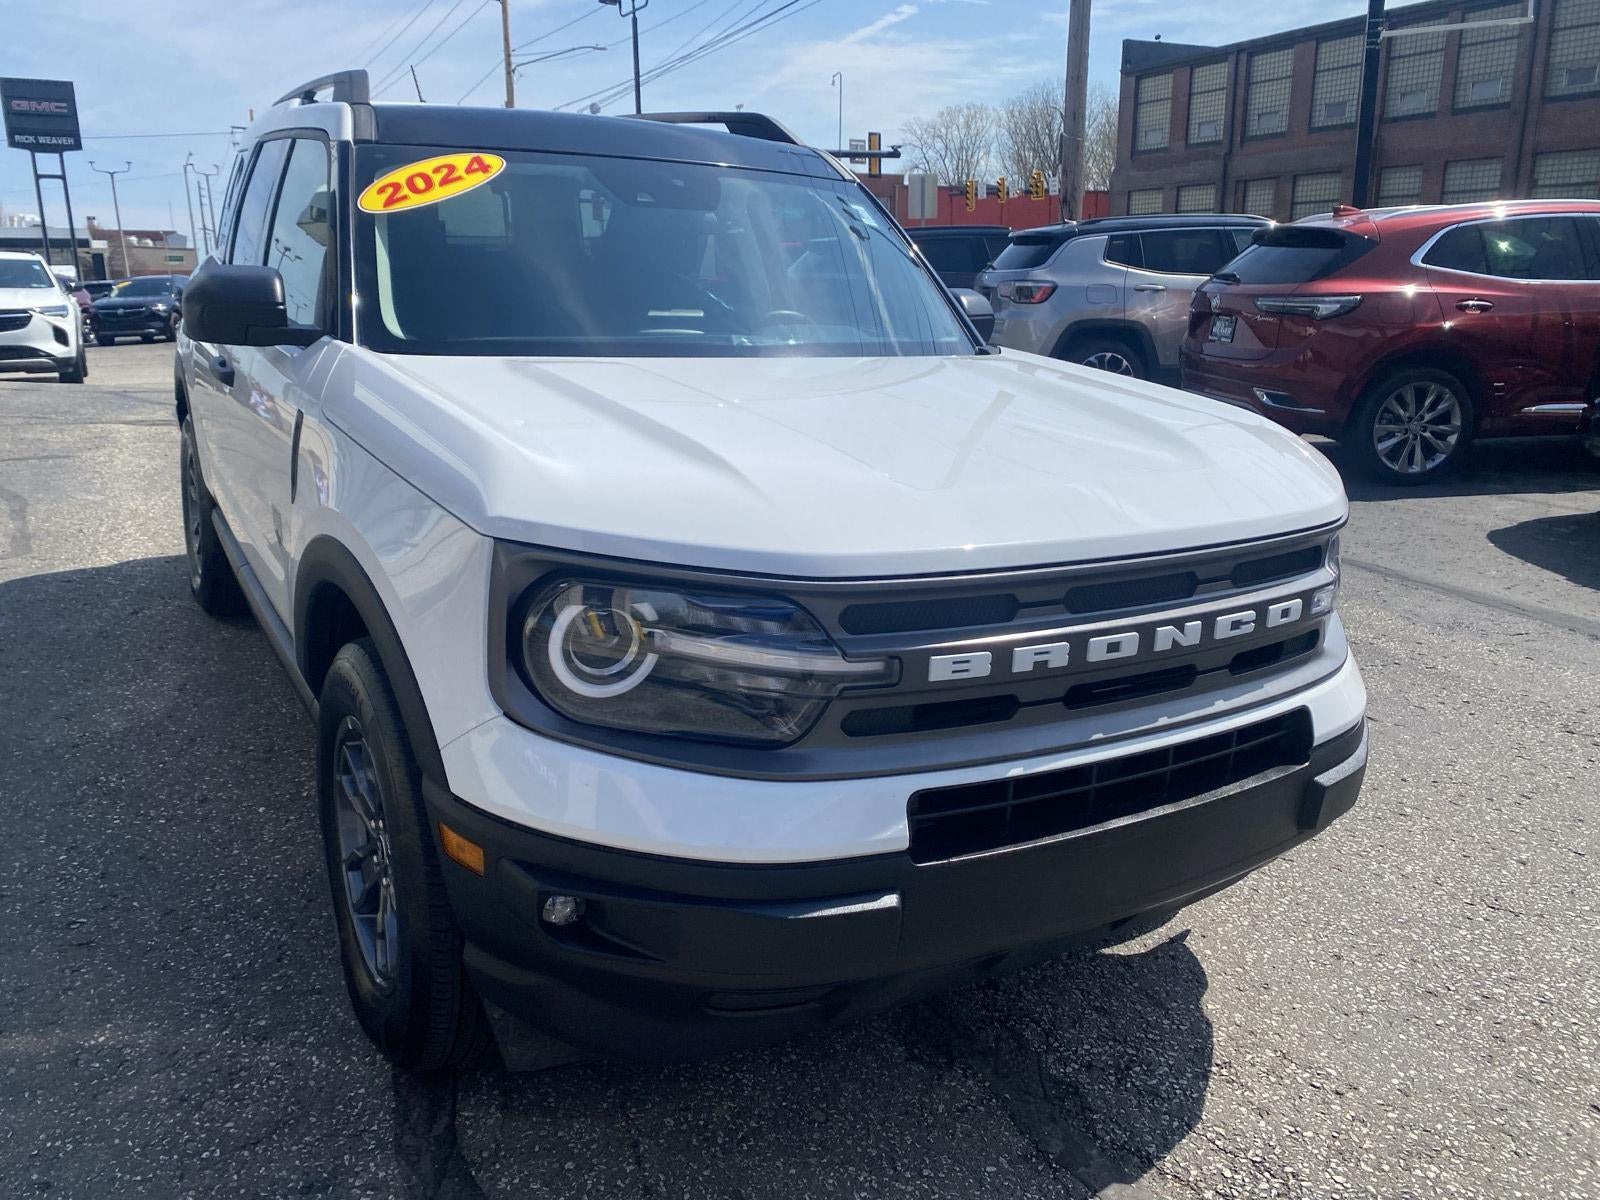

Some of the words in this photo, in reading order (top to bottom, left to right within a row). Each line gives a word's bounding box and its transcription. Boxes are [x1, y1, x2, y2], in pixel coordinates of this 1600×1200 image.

[11, 100, 68, 113] GMC
[14, 135, 36, 144] RICK
[37, 135, 74, 145] WEAVER
[377, 155, 492, 208] 2024
[928, 598, 1303, 682] BRONCO
